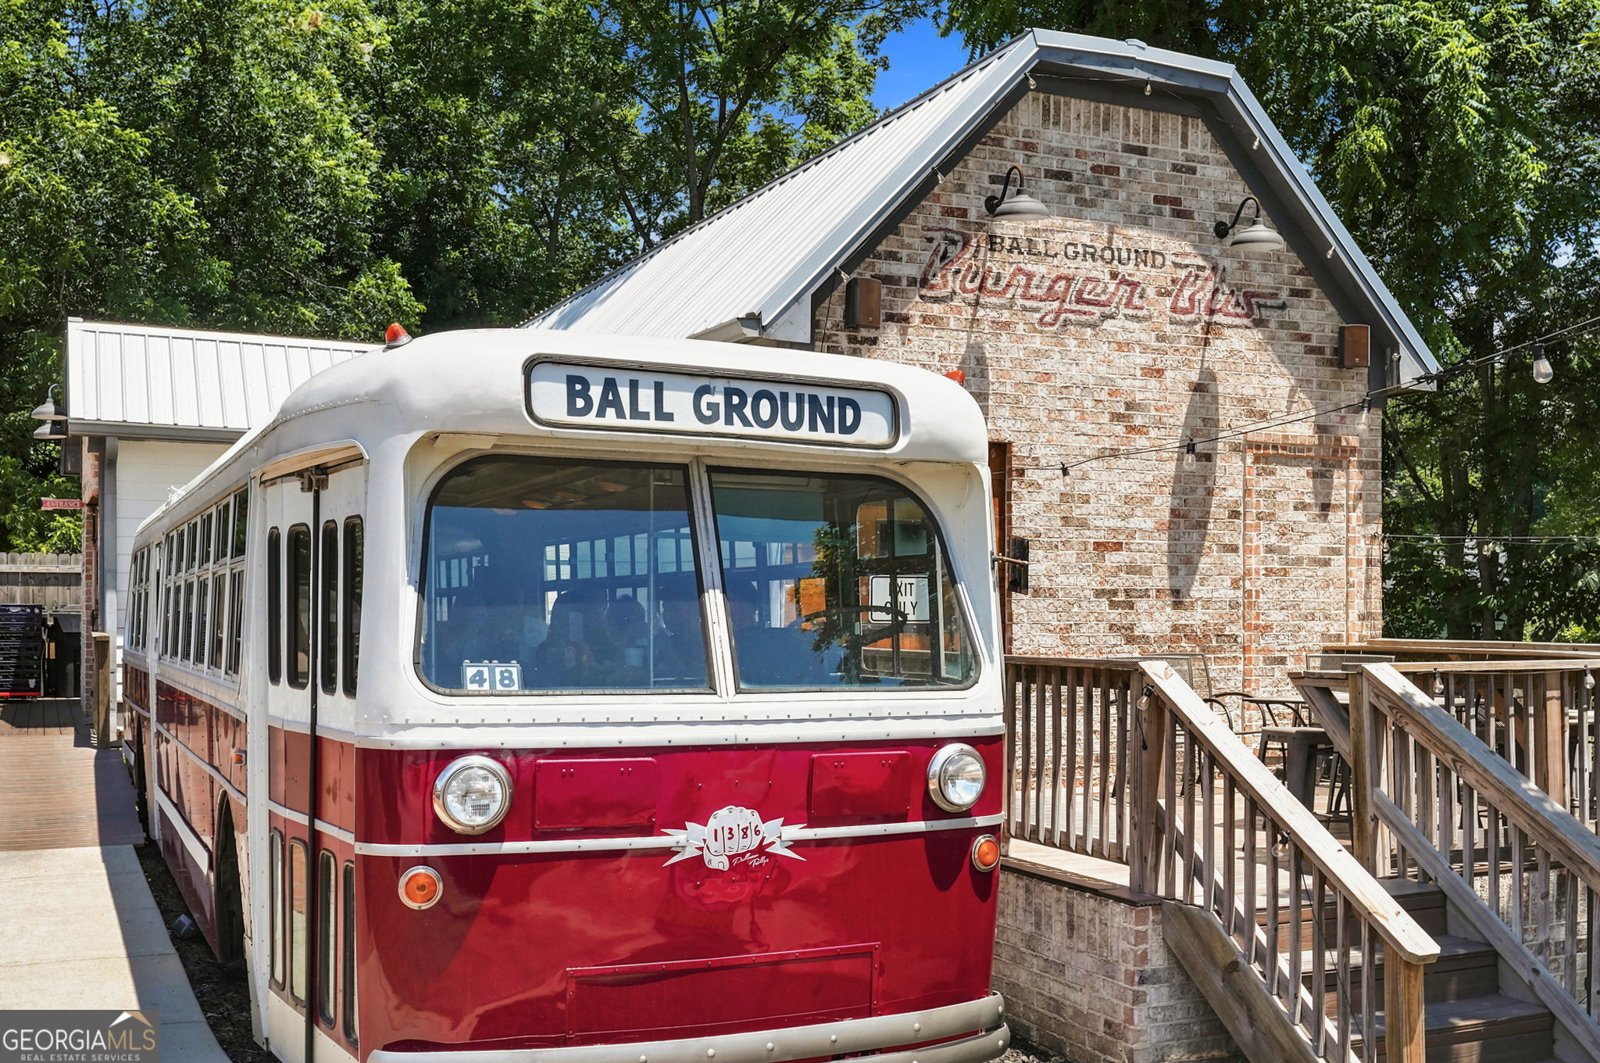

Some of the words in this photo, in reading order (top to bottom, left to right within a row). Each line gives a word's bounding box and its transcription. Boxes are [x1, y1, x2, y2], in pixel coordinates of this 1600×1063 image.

[988, 234, 1057, 260] BALL
[1063, 243, 1167, 270] GROUND
[918, 226, 1145, 329] Burger
[1168, 252, 1287, 320] Bus
[565, 374, 675, 422] BALL
[692, 384, 862, 436] GROUND
[889, 582, 915, 597] XIT
[884, 601, 918, 616] OLY
[712, 824, 761, 842] 1386
